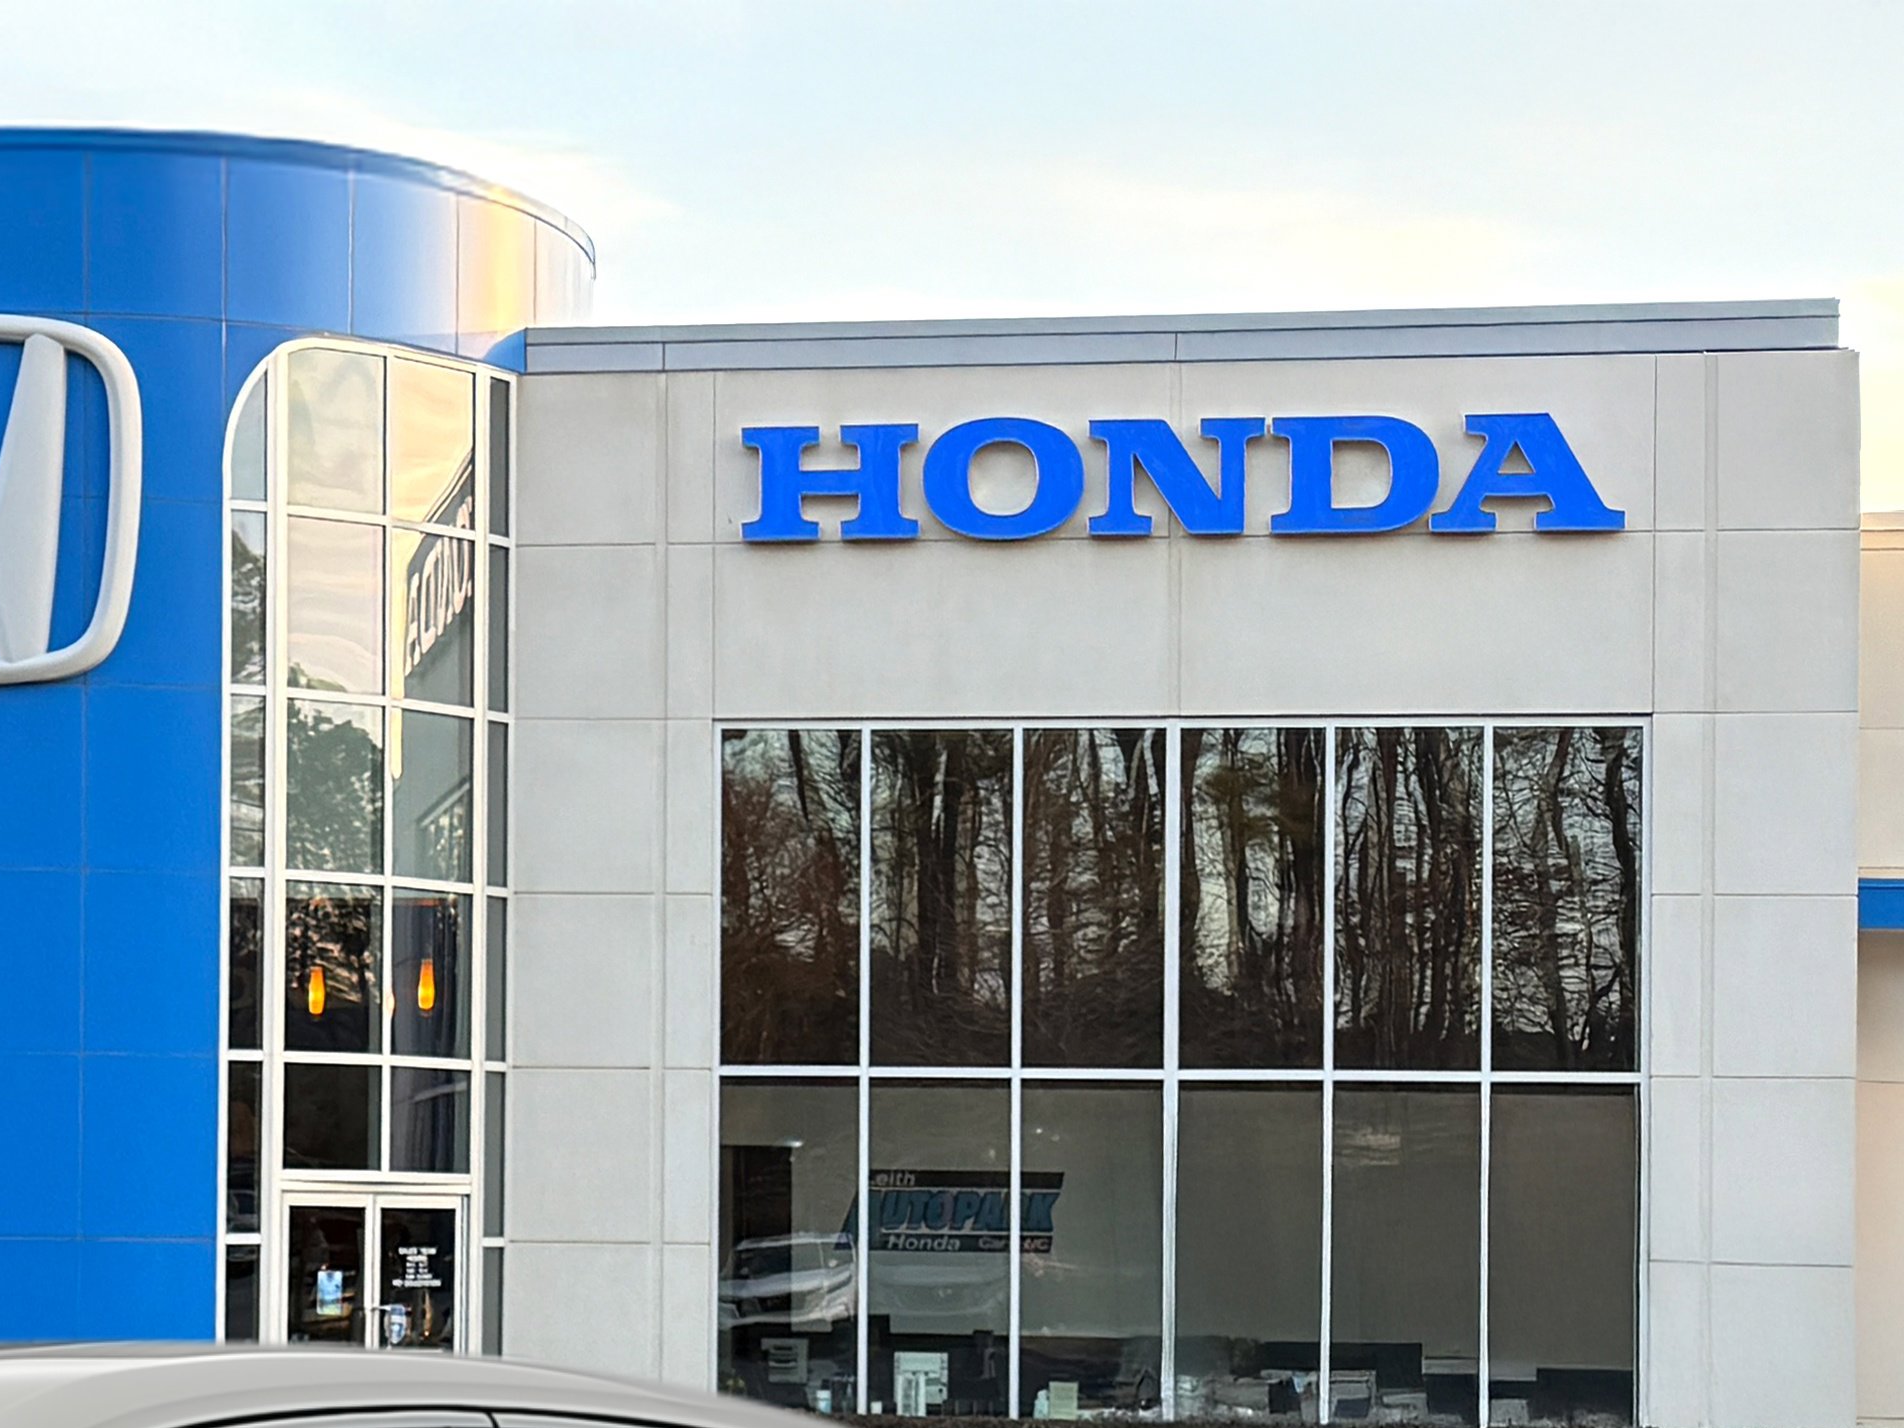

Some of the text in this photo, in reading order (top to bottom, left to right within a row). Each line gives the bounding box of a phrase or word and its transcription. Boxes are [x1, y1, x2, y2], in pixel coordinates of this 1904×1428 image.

[740, 411, 1627, 542] HONDA
[869, 1171, 916, 1187] eith
[887, 1235, 961, 1251] Honda
